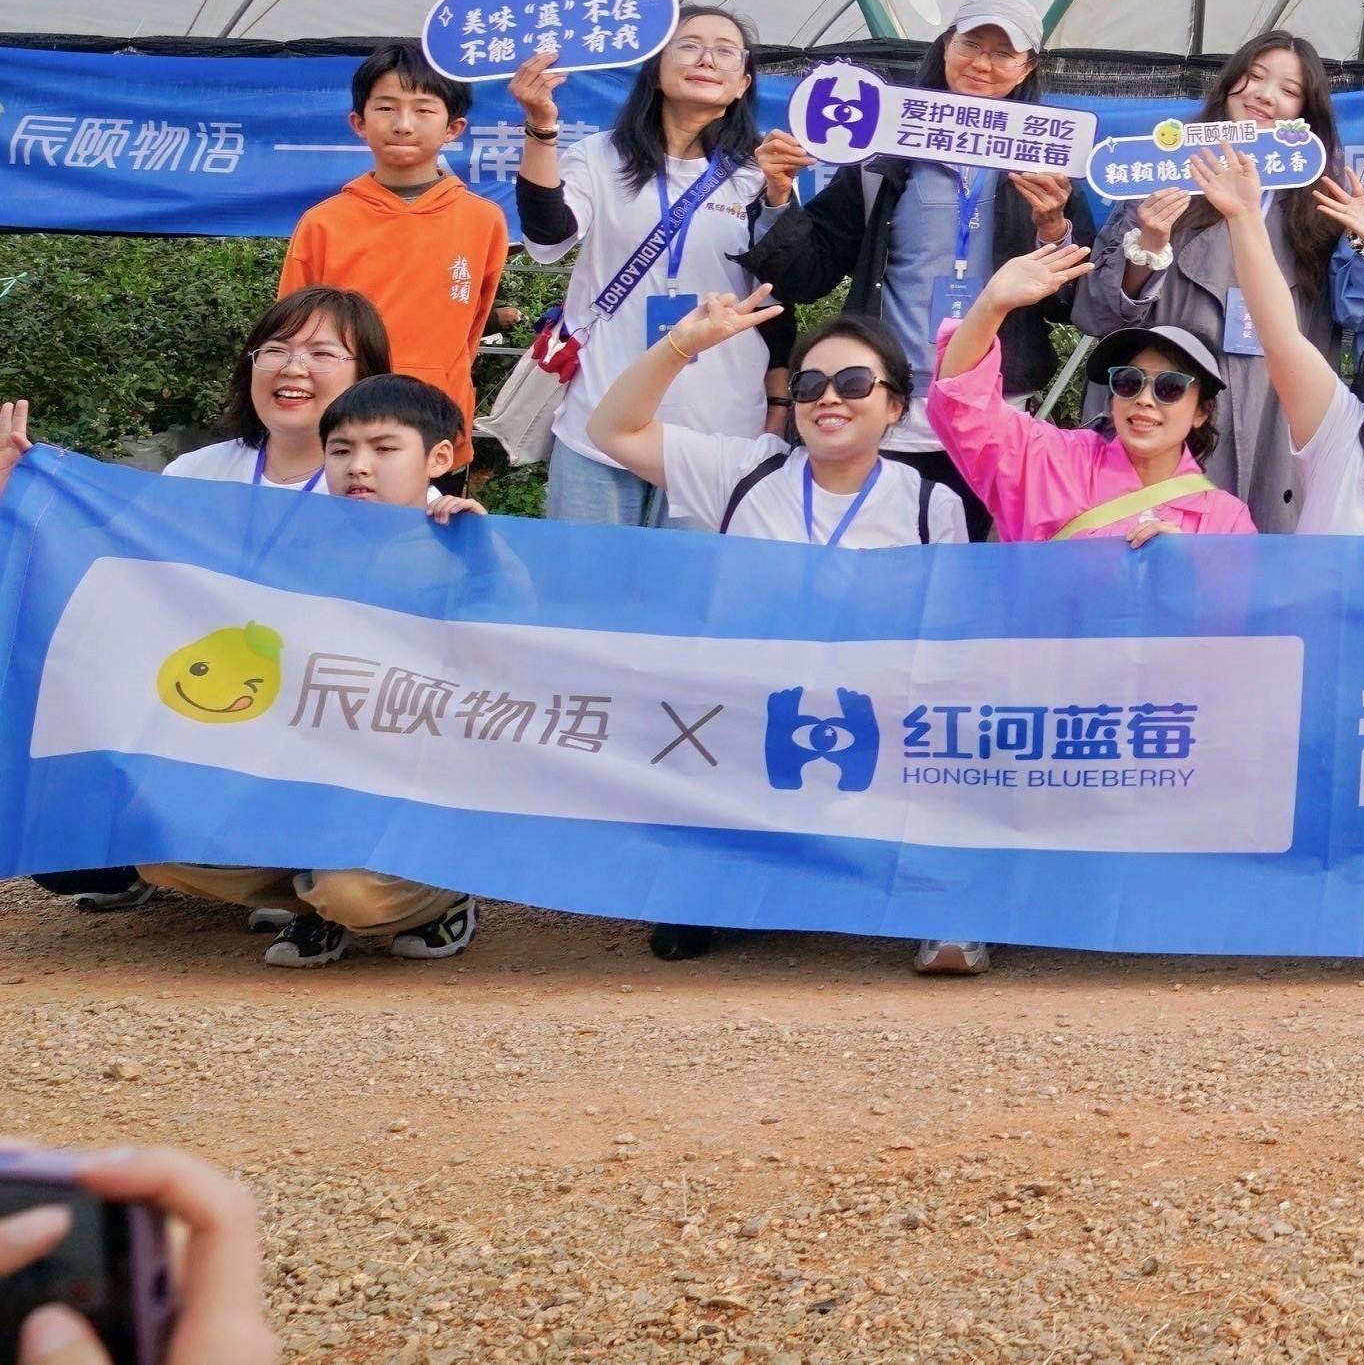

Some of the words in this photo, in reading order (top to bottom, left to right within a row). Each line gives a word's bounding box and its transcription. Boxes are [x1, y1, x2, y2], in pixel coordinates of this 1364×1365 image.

[900, 98, 1010, 132] 爱护眼睛
[1022, 114, 1078, 141] 多吃
[1186, 122, 1257, 144] 辰颐物语
[9, 114, 246, 175] 辰颐物语
[896, 123, 1073, 168] 云南红河蓝莓
[600, 285, 628, 314] HOT
[288, 651, 613, 754] 辰颐物语
[902, 702, 1199, 761] 红河蓝莓
[902, 766, 1018, 788] HONGHE
[1027, 767, 1196, 789] BLUEBERRY
